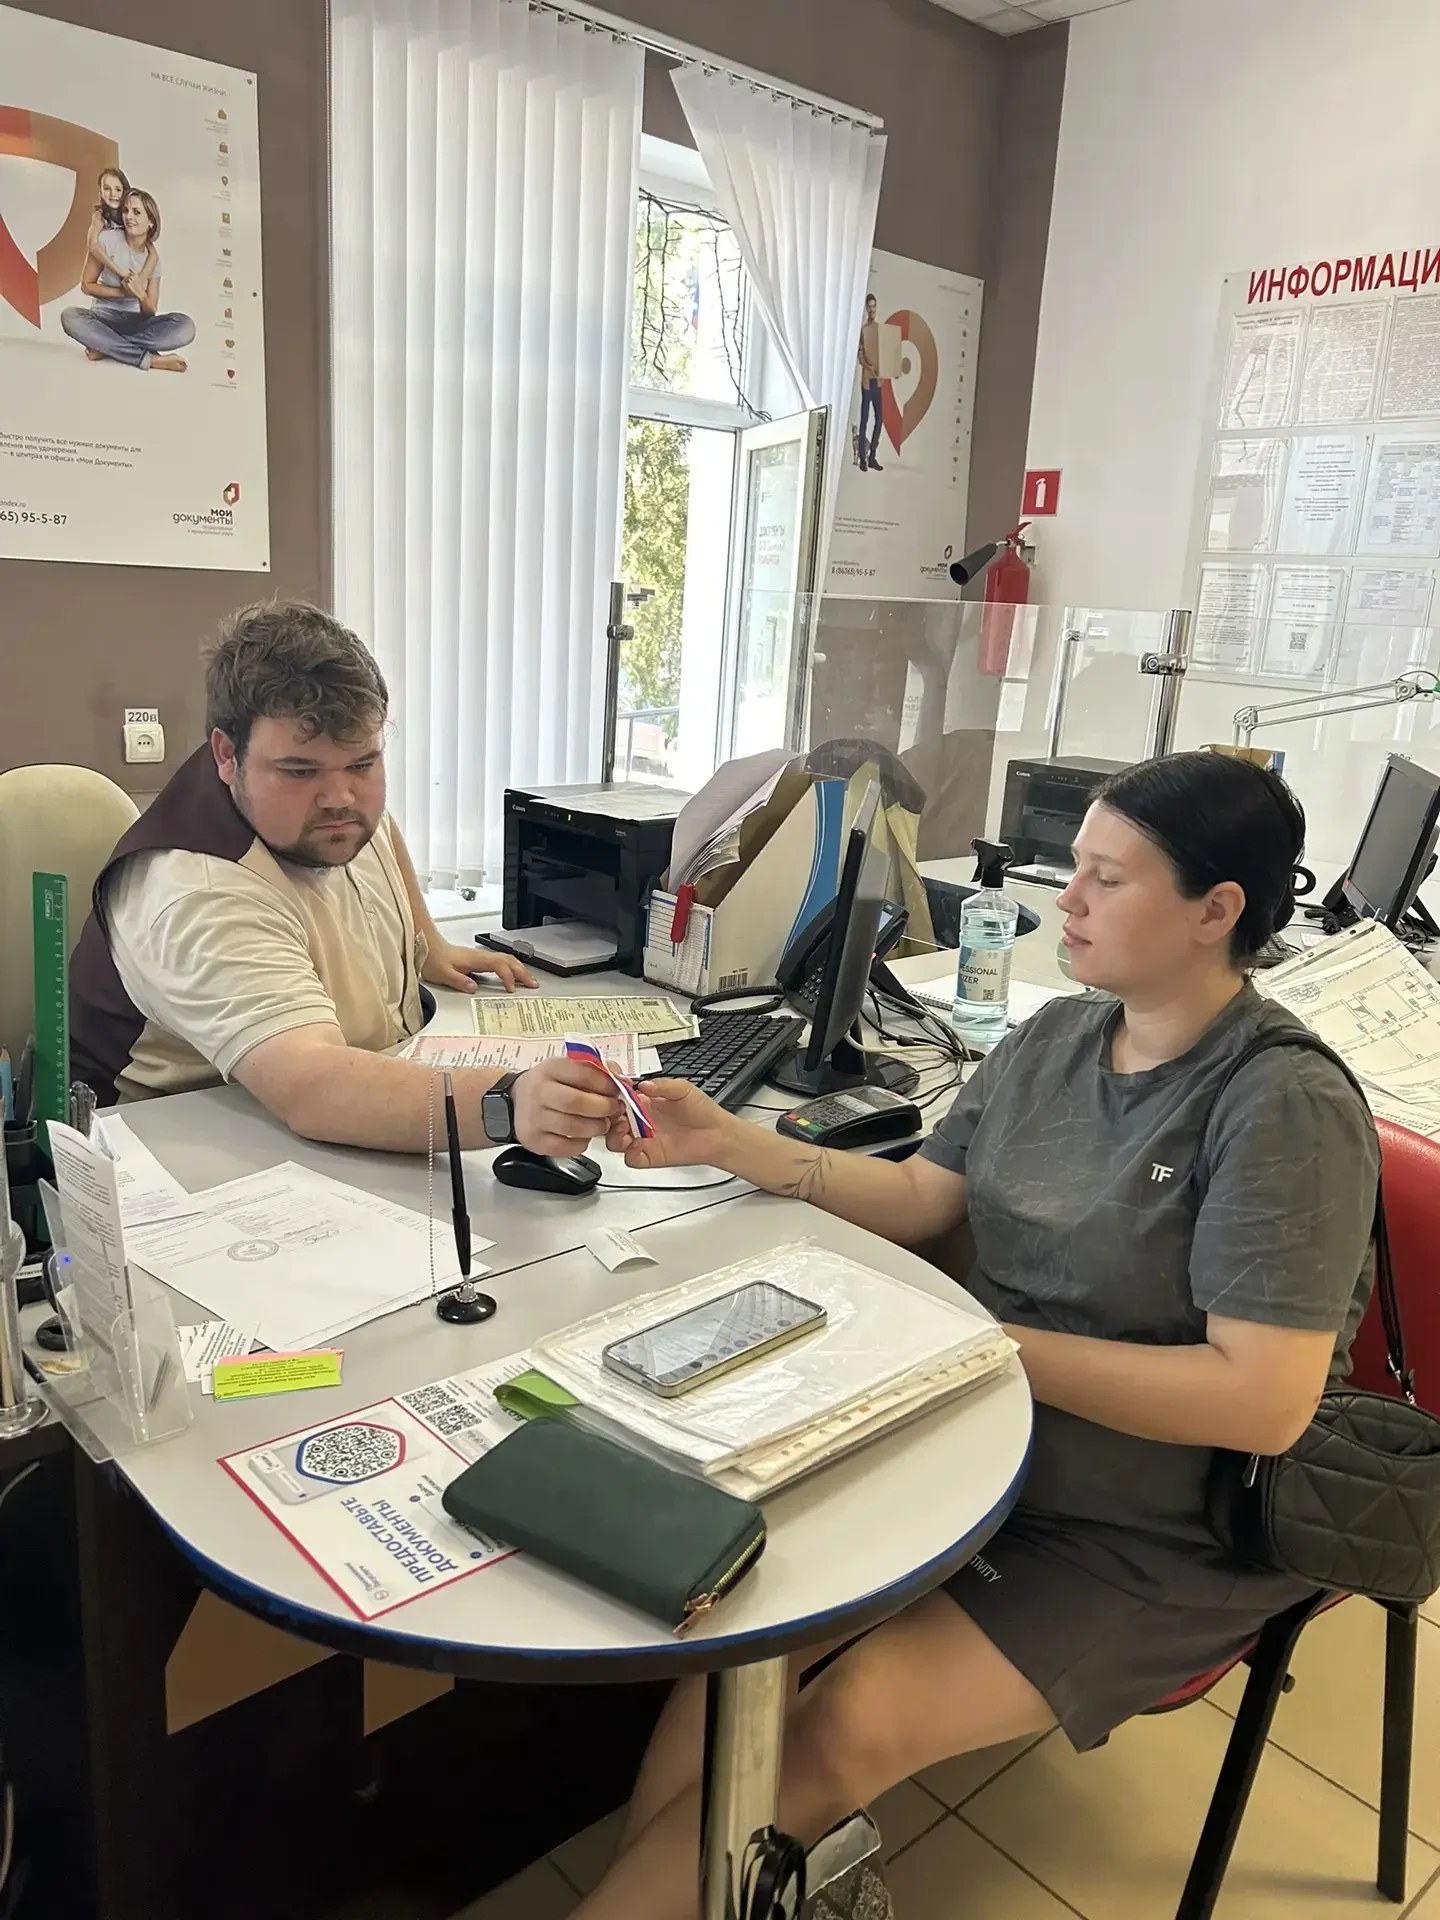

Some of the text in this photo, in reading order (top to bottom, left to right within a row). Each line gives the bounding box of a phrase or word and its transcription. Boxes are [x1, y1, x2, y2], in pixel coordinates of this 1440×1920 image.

[21, 512, 67, 525] 95-5-87
[340, 1497, 435, 1583] ПРЕДОСТАВЬТЕ
[372, 1499, 459, 1572] ДОКУМЕНТЫ
